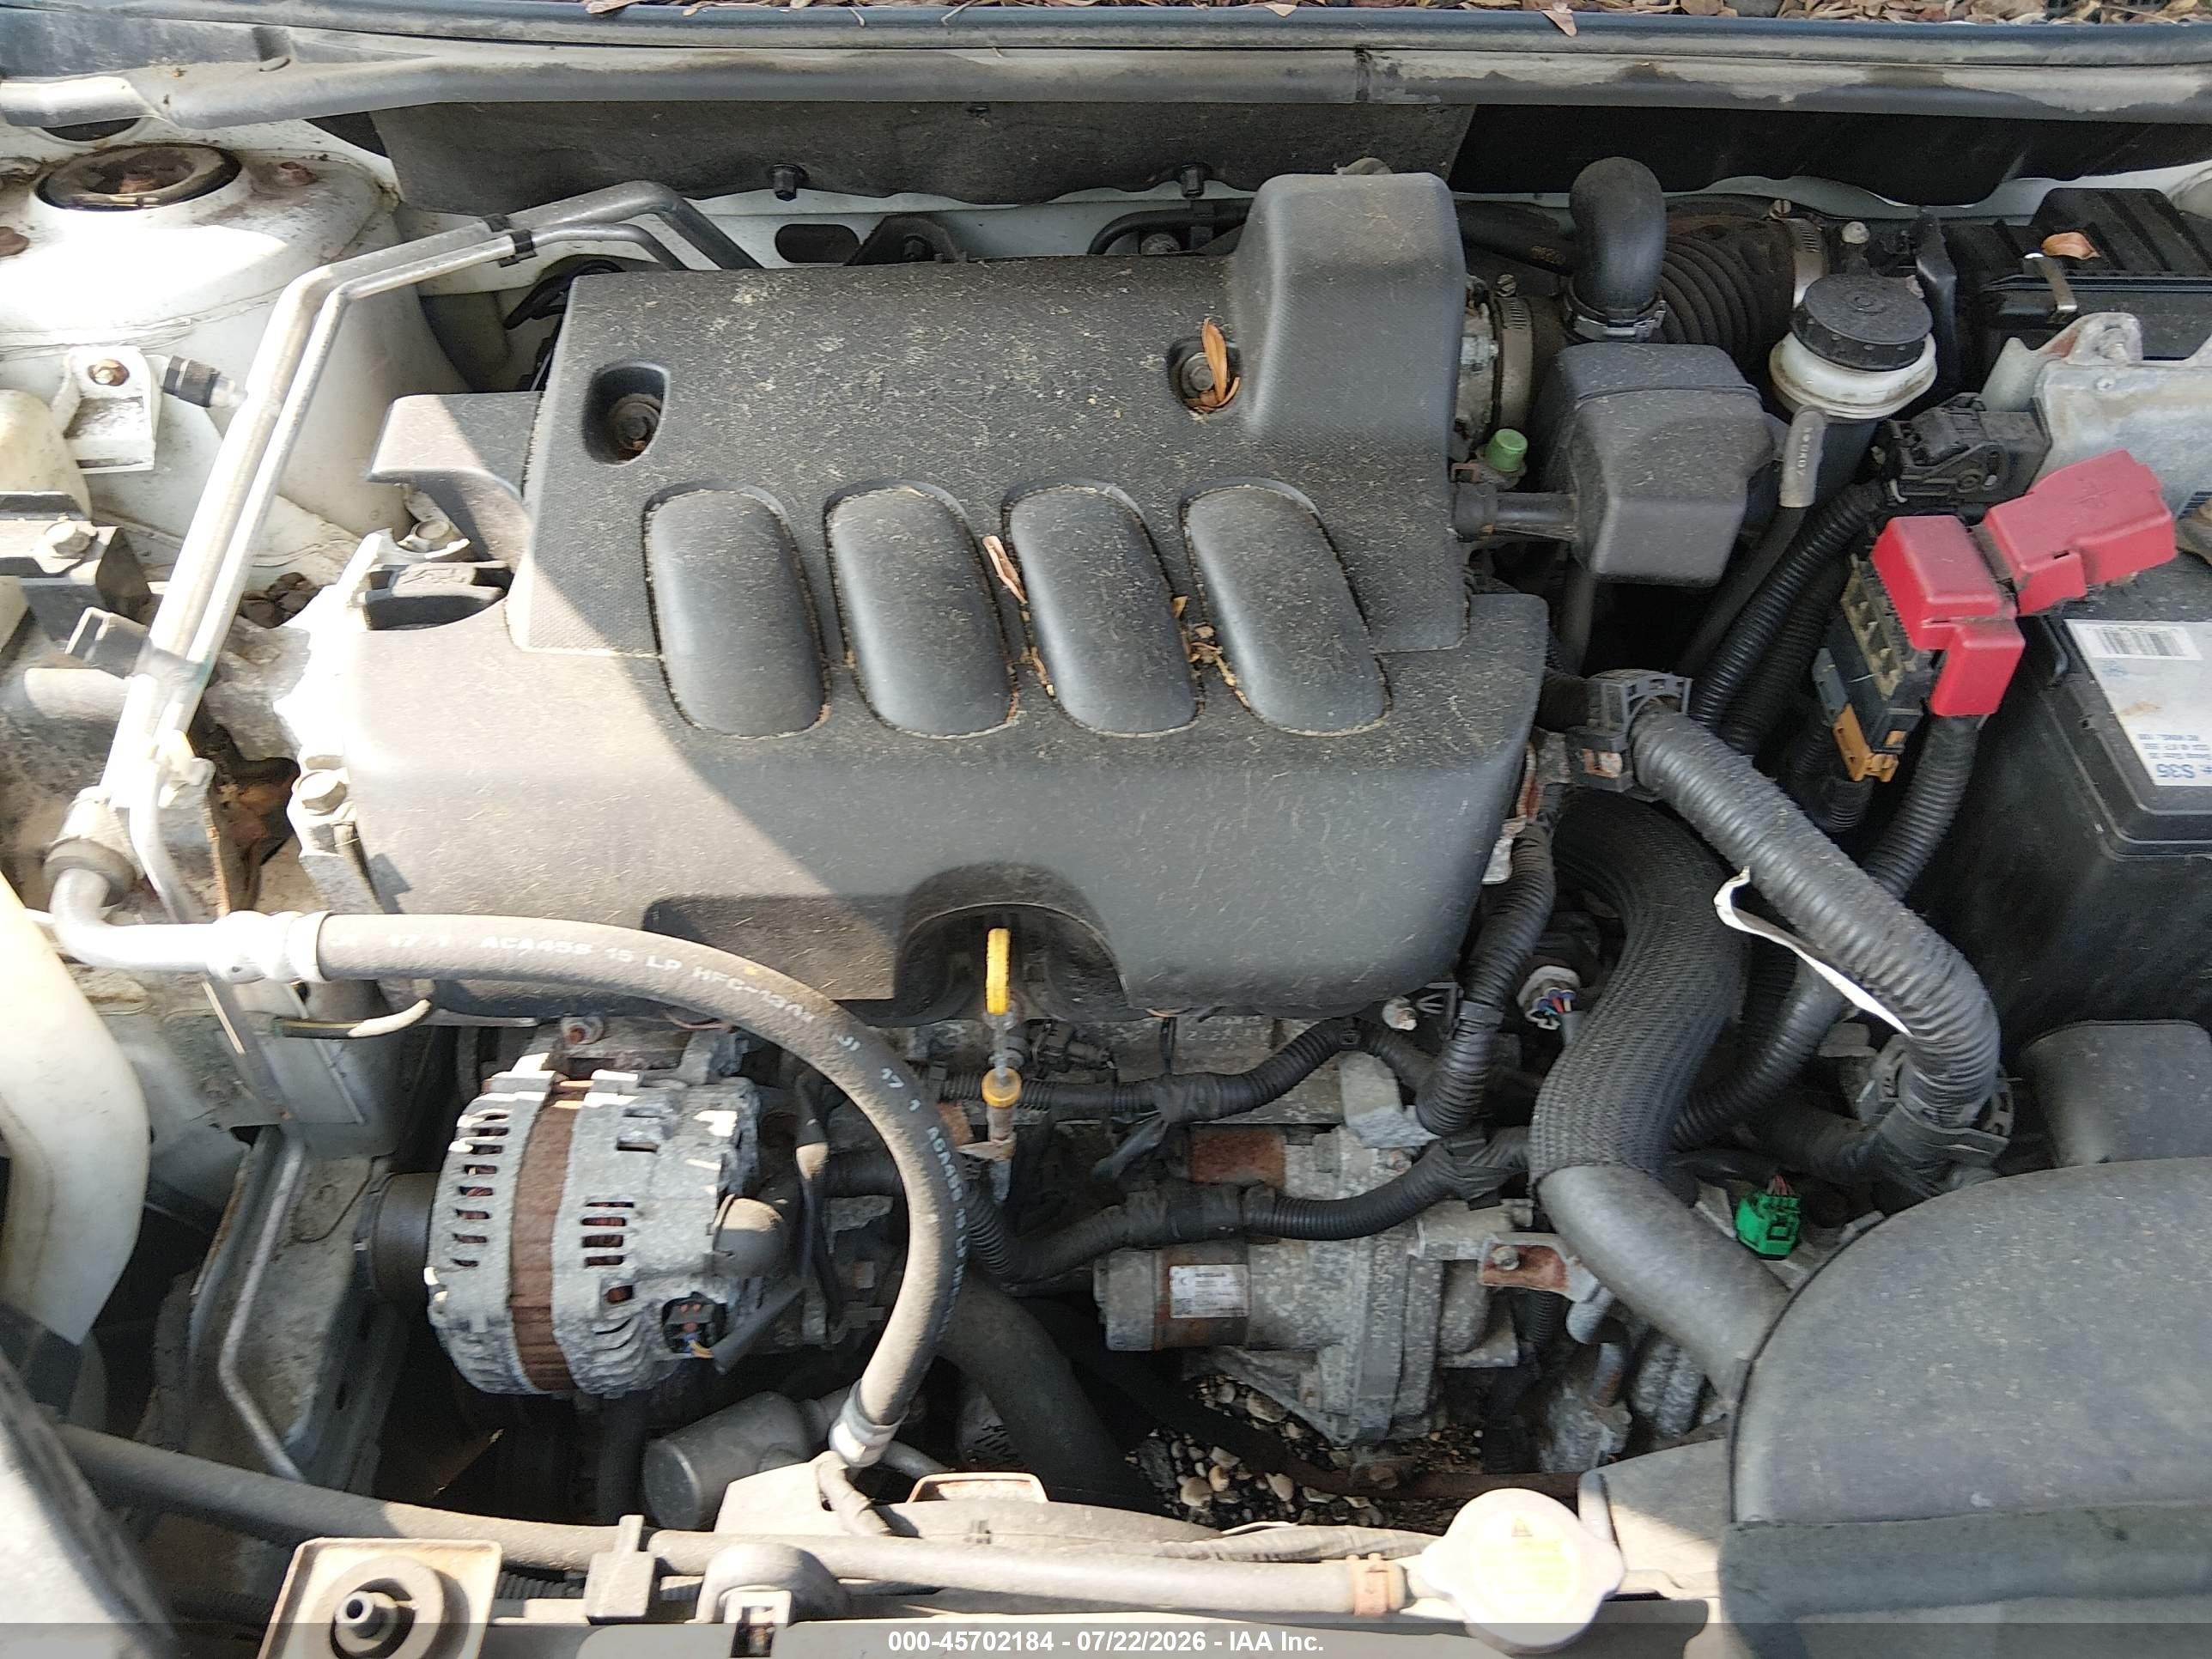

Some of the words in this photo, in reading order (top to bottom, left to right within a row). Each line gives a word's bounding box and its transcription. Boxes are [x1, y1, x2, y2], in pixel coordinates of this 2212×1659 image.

[2155, 763, 2196, 779] S35
[645, 954, 683, 970] LP
[880, 1066, 905, 1089] 17
[908, 1097, 921, 1112] 1
